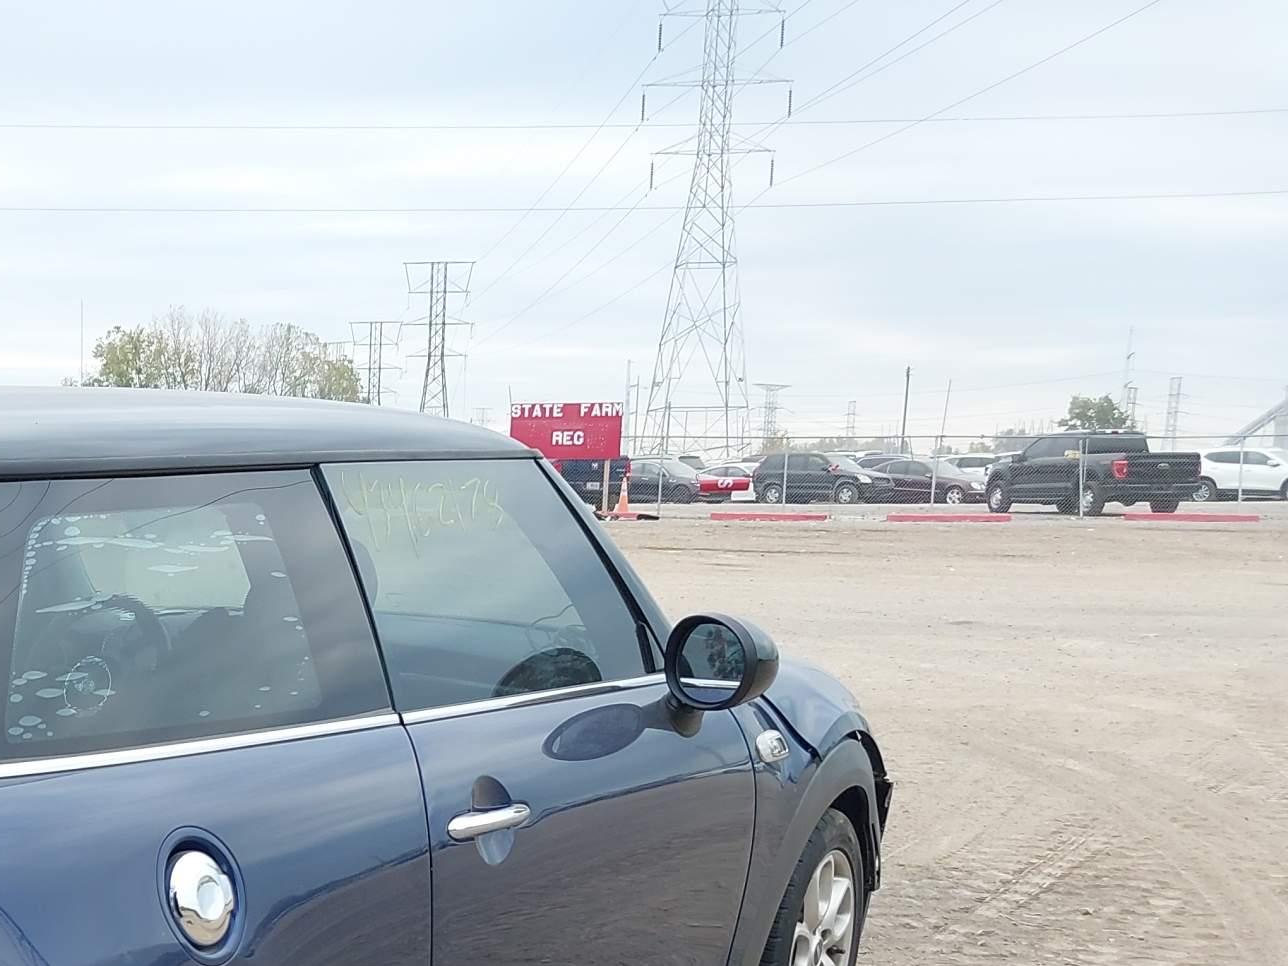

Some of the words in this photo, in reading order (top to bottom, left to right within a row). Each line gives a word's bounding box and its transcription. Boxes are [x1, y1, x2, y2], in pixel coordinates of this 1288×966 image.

[511, 403, 563, 418] STATE
[580, 403, 624, 417] FARM
[551, 430, 585, 446] REG
